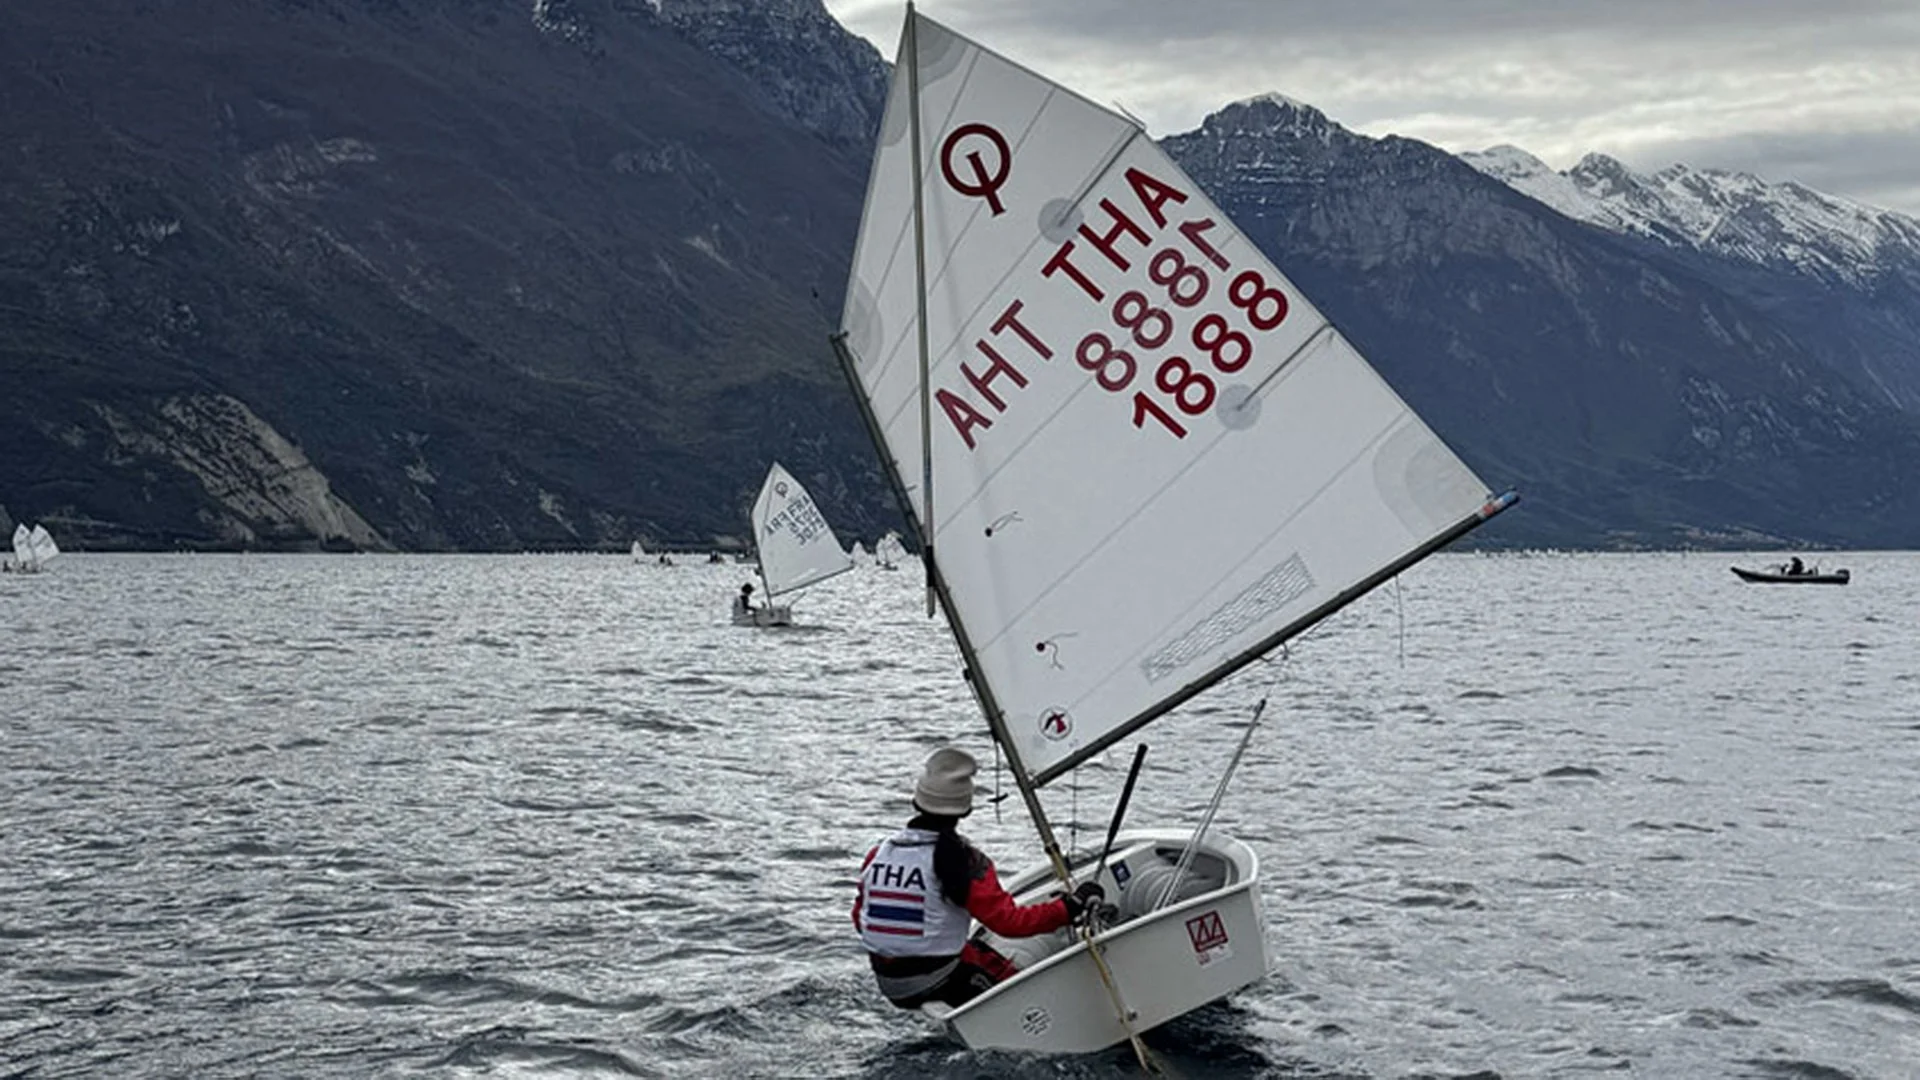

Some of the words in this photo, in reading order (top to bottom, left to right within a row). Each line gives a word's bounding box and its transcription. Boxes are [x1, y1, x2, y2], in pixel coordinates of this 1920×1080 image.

[1041, 167, 1189, 303] THA
[1133, 270, 1289, 440] 1888
[871, 863, 926, 890] THA
